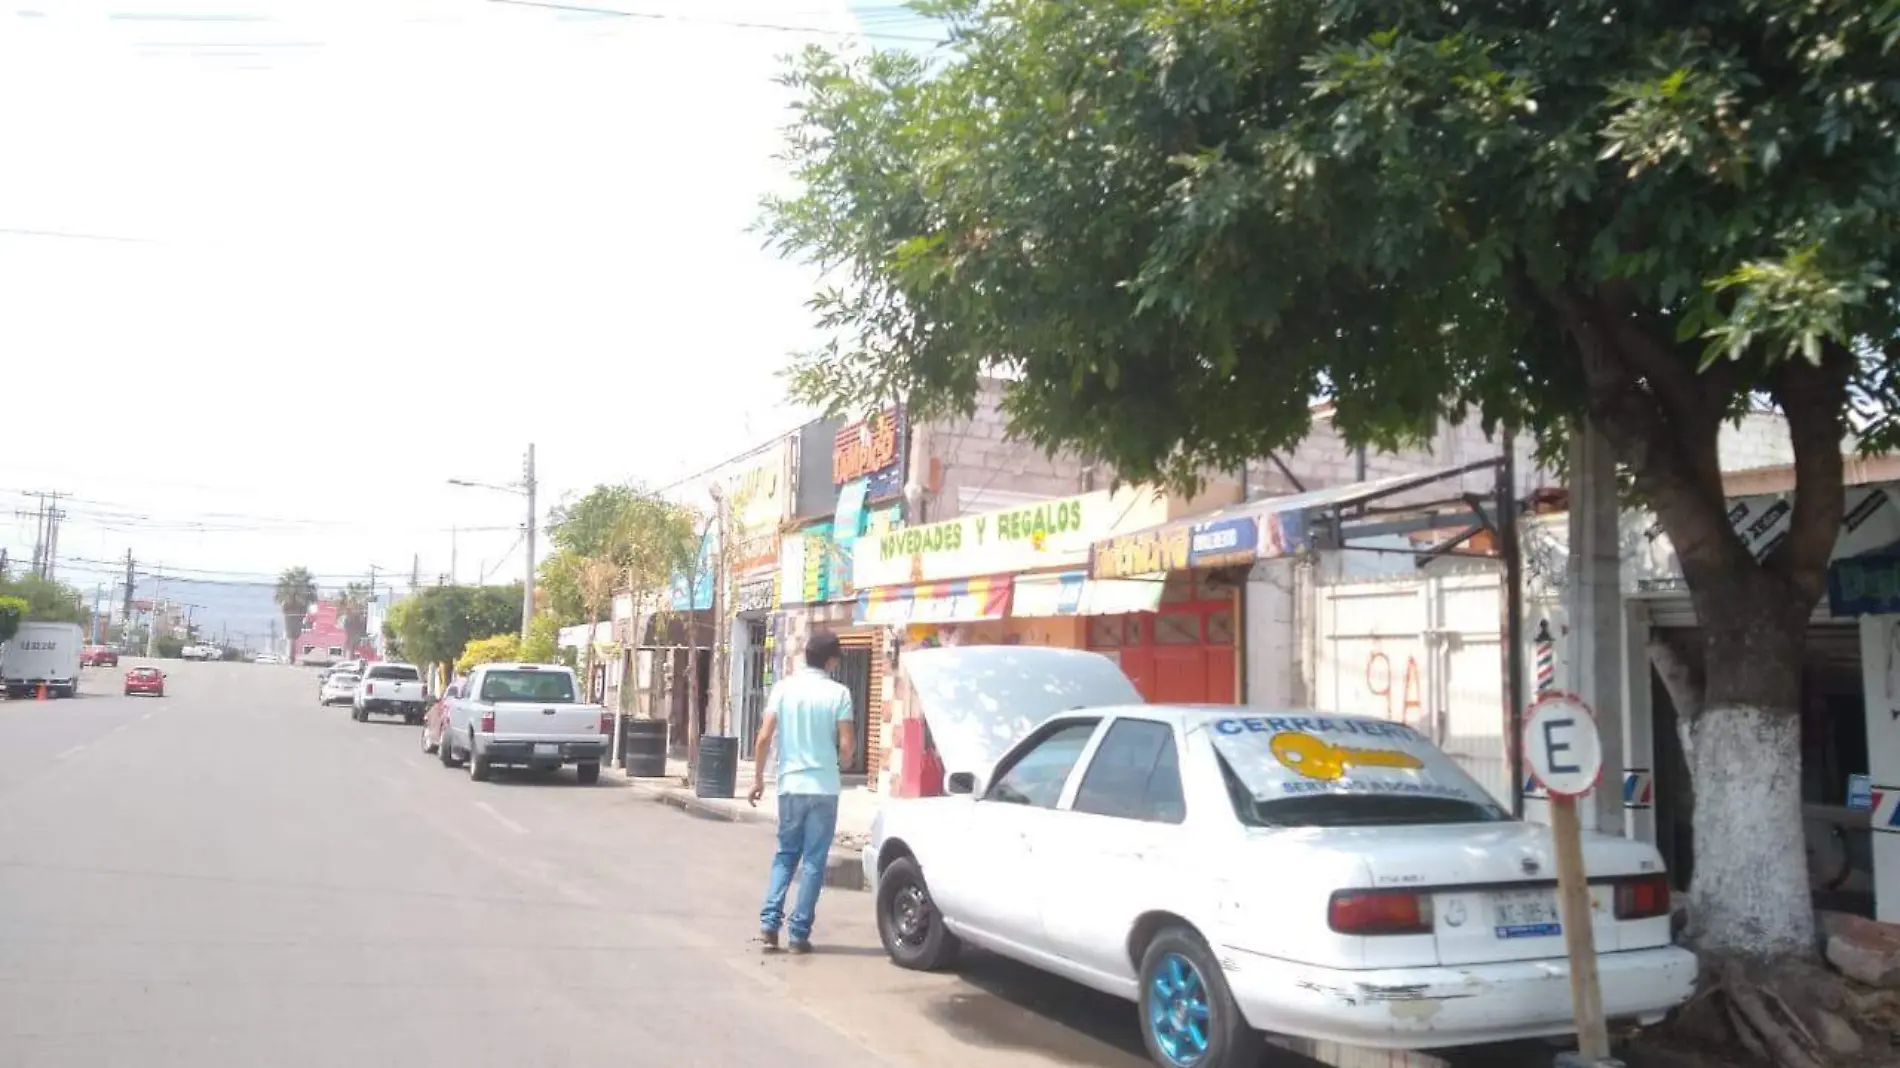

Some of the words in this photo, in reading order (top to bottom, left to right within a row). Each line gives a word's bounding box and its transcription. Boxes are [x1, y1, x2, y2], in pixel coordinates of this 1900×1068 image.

[880, 522, 963, 561] NOVEDADES
[975, 516, 986, 545] Y
[997, 500, 1081, 541] REGALOS
[1543, 718, 1582, 774] E
